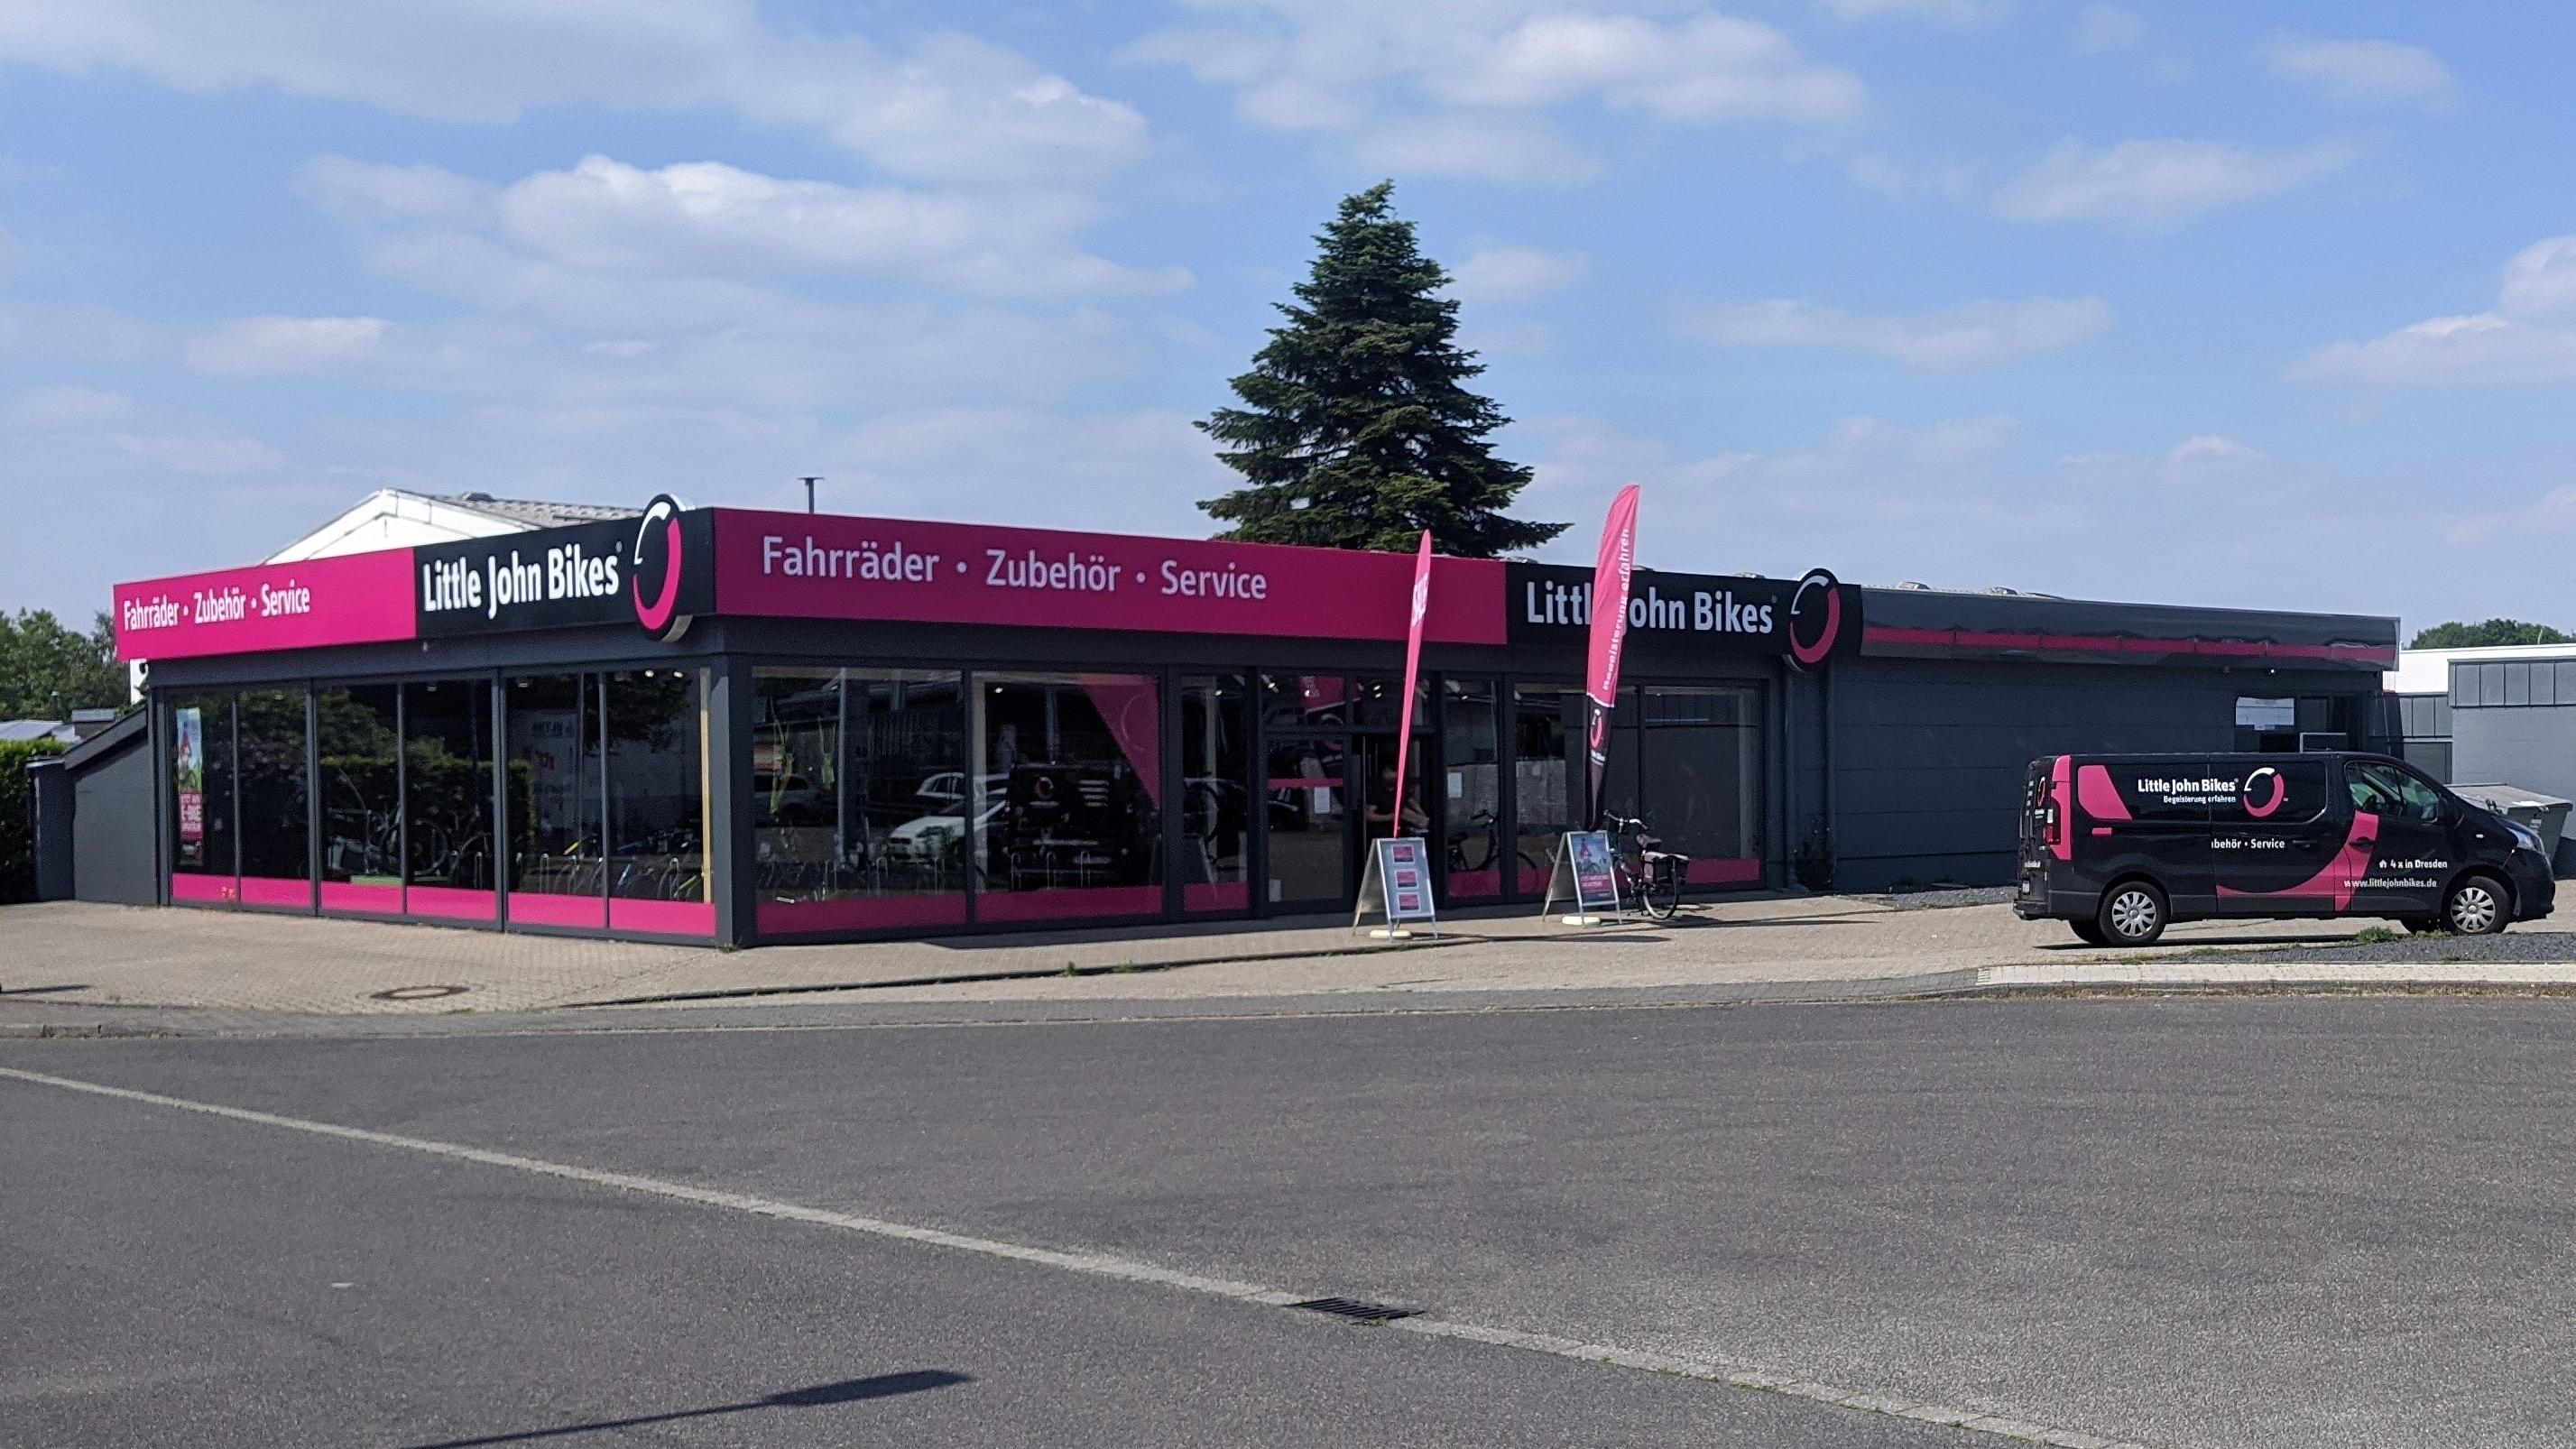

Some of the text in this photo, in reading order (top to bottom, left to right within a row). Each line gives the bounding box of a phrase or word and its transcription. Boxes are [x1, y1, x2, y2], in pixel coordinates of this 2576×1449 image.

[763, 536, 1267, 600] Fahrräder Zubehör Service
[1618, 528, 1631, 592] erfahren
[422, 543, 620, 620] Little John Bikes
[124, 578, 310, 632] Fahrräder Zubehör Service
[1527, 580, 1773, 635] Littl ohn Bikes
[2137, 778, 2236, 795] Little John Bikes
[2207, 795, 2237, 803] erfahren
[2250, 838, 2285, 849] Service
[2389, 859, 2396, 868] 4
[2405, 859, 2413, 868] in
[2414, 859, 2448, 869] Dresden
[2343, 877, 2437, 889] www.littlejohnbikes.de
